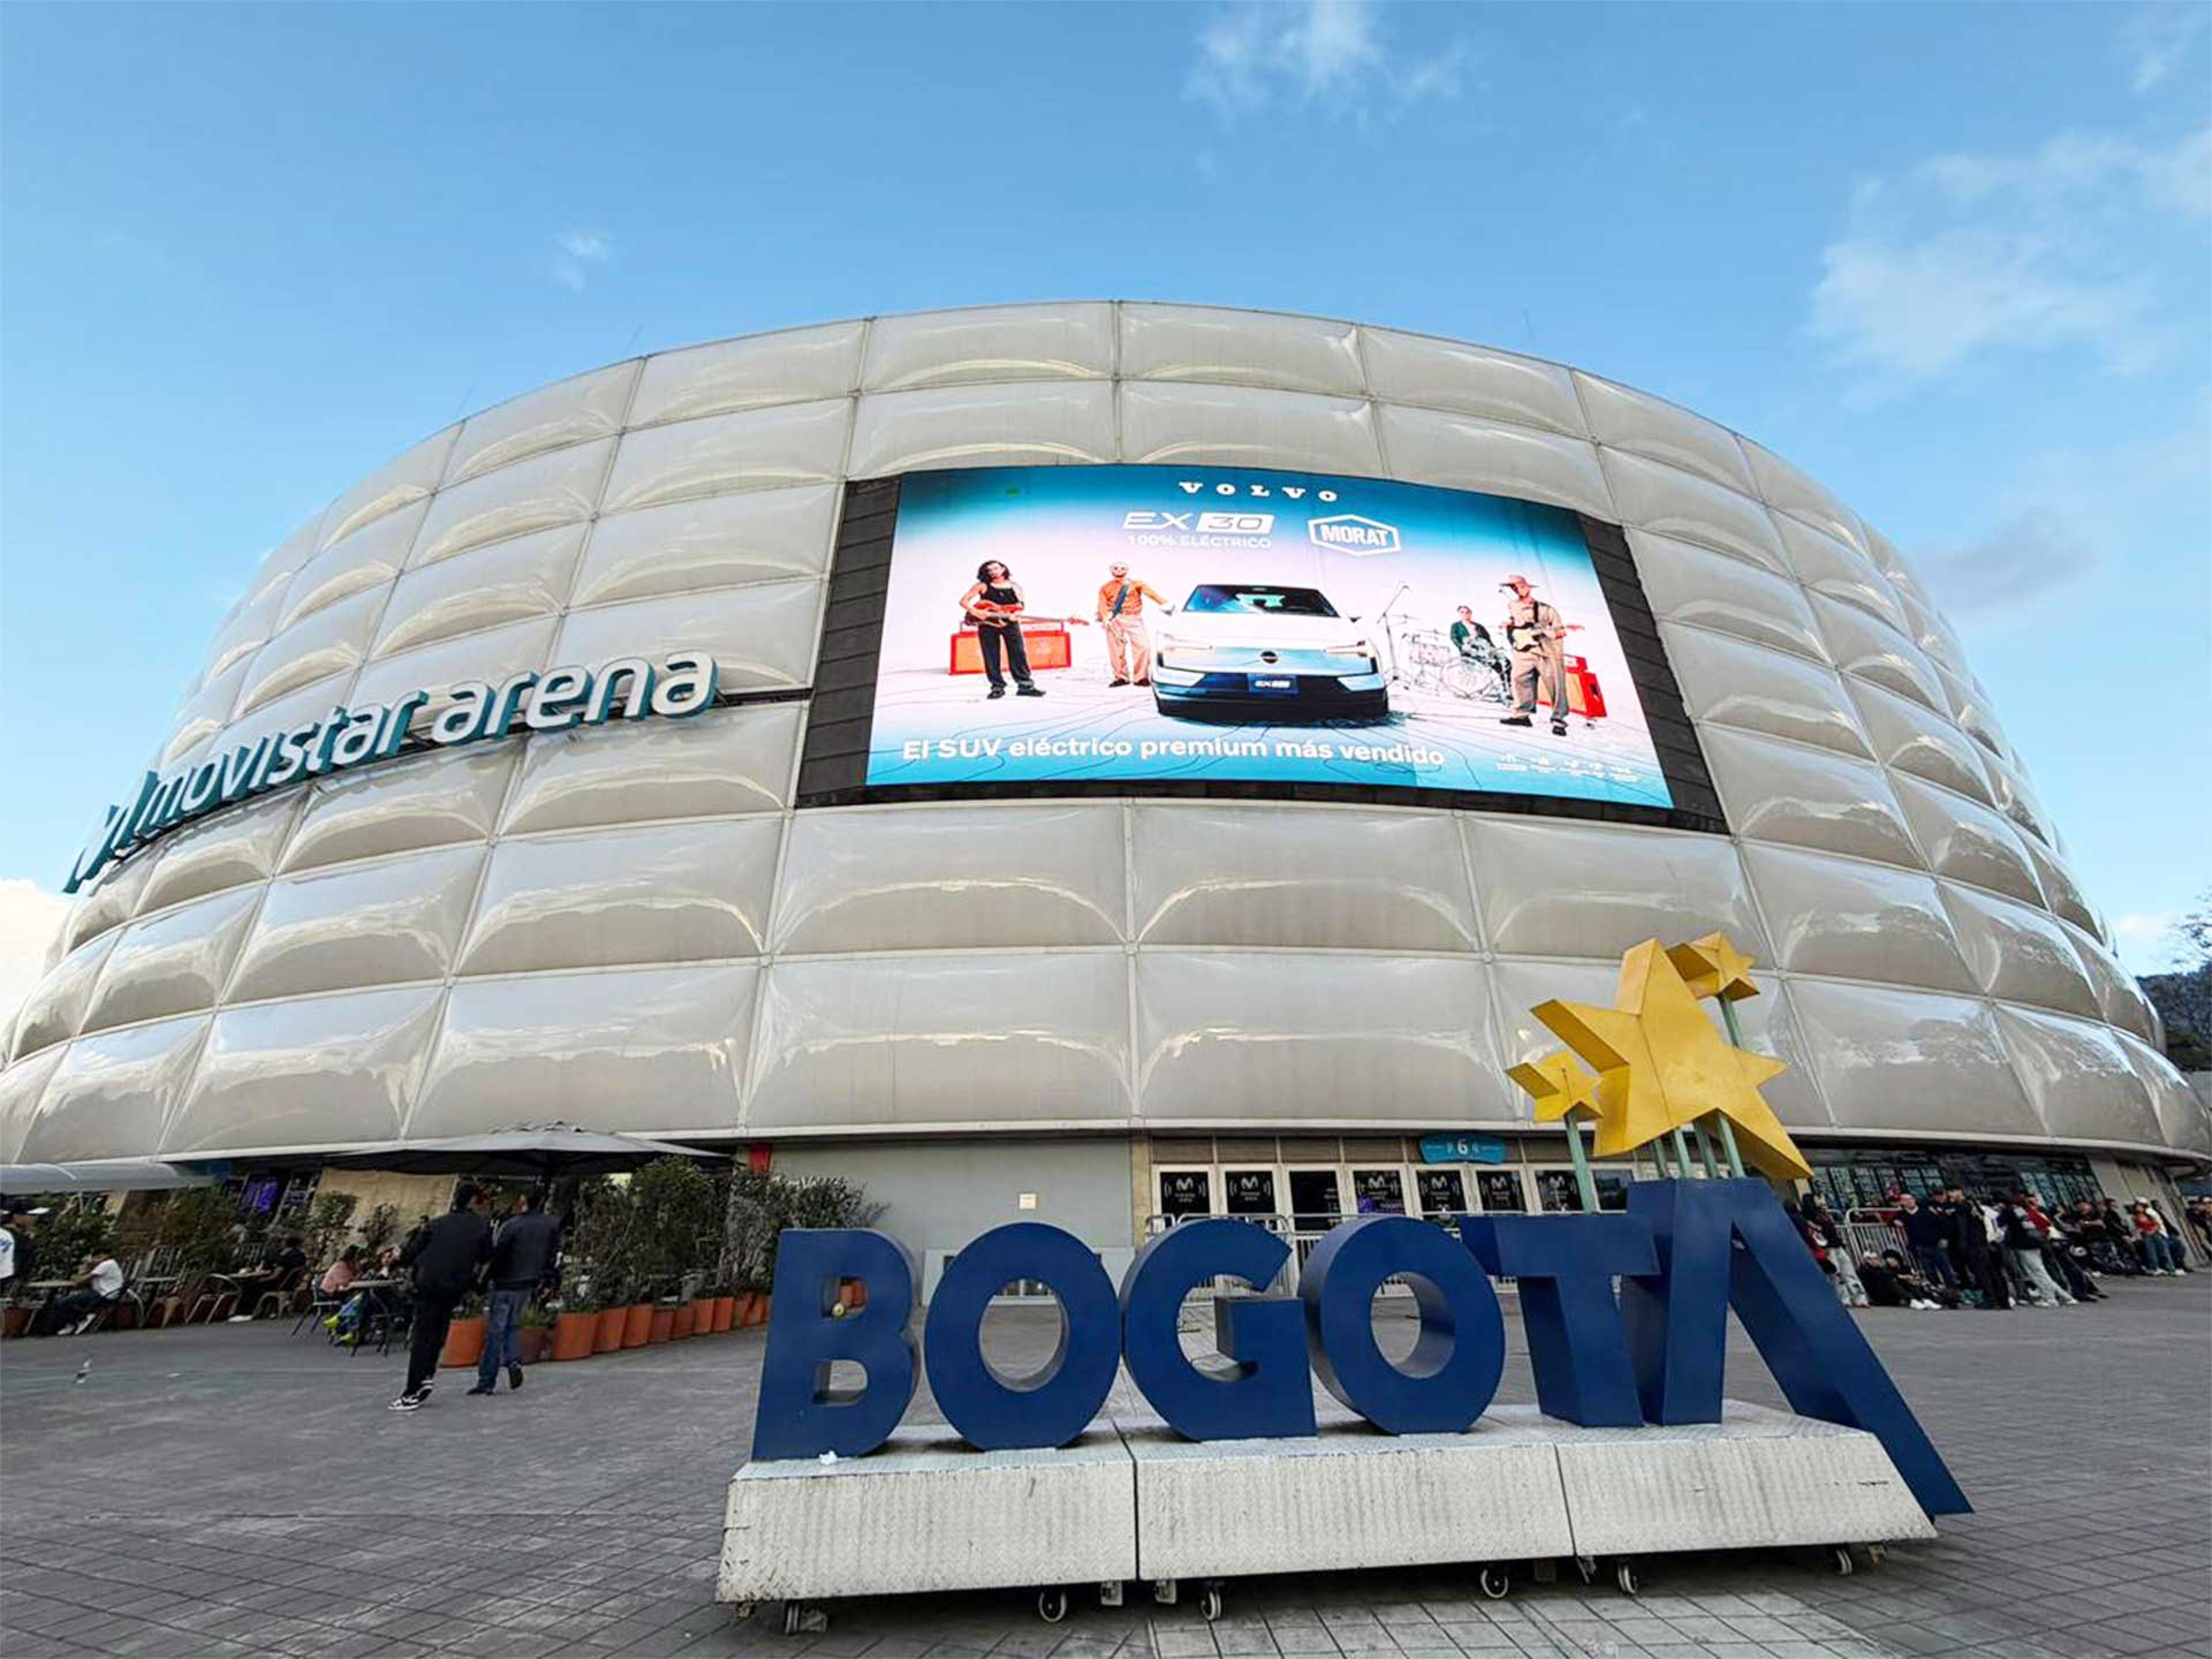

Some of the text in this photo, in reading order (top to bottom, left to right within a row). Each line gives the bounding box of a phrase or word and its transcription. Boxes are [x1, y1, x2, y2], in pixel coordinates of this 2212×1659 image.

[1179, 482, 1338, 502] VOLVO
[1130, 533, 1174, 547] 100%
[1321, 524, 1388, 546] MORAT
[132, 651, 719, 838] movistar arena
[903, 736, 1445, 765] El SUV eléctrico premium más vendido
